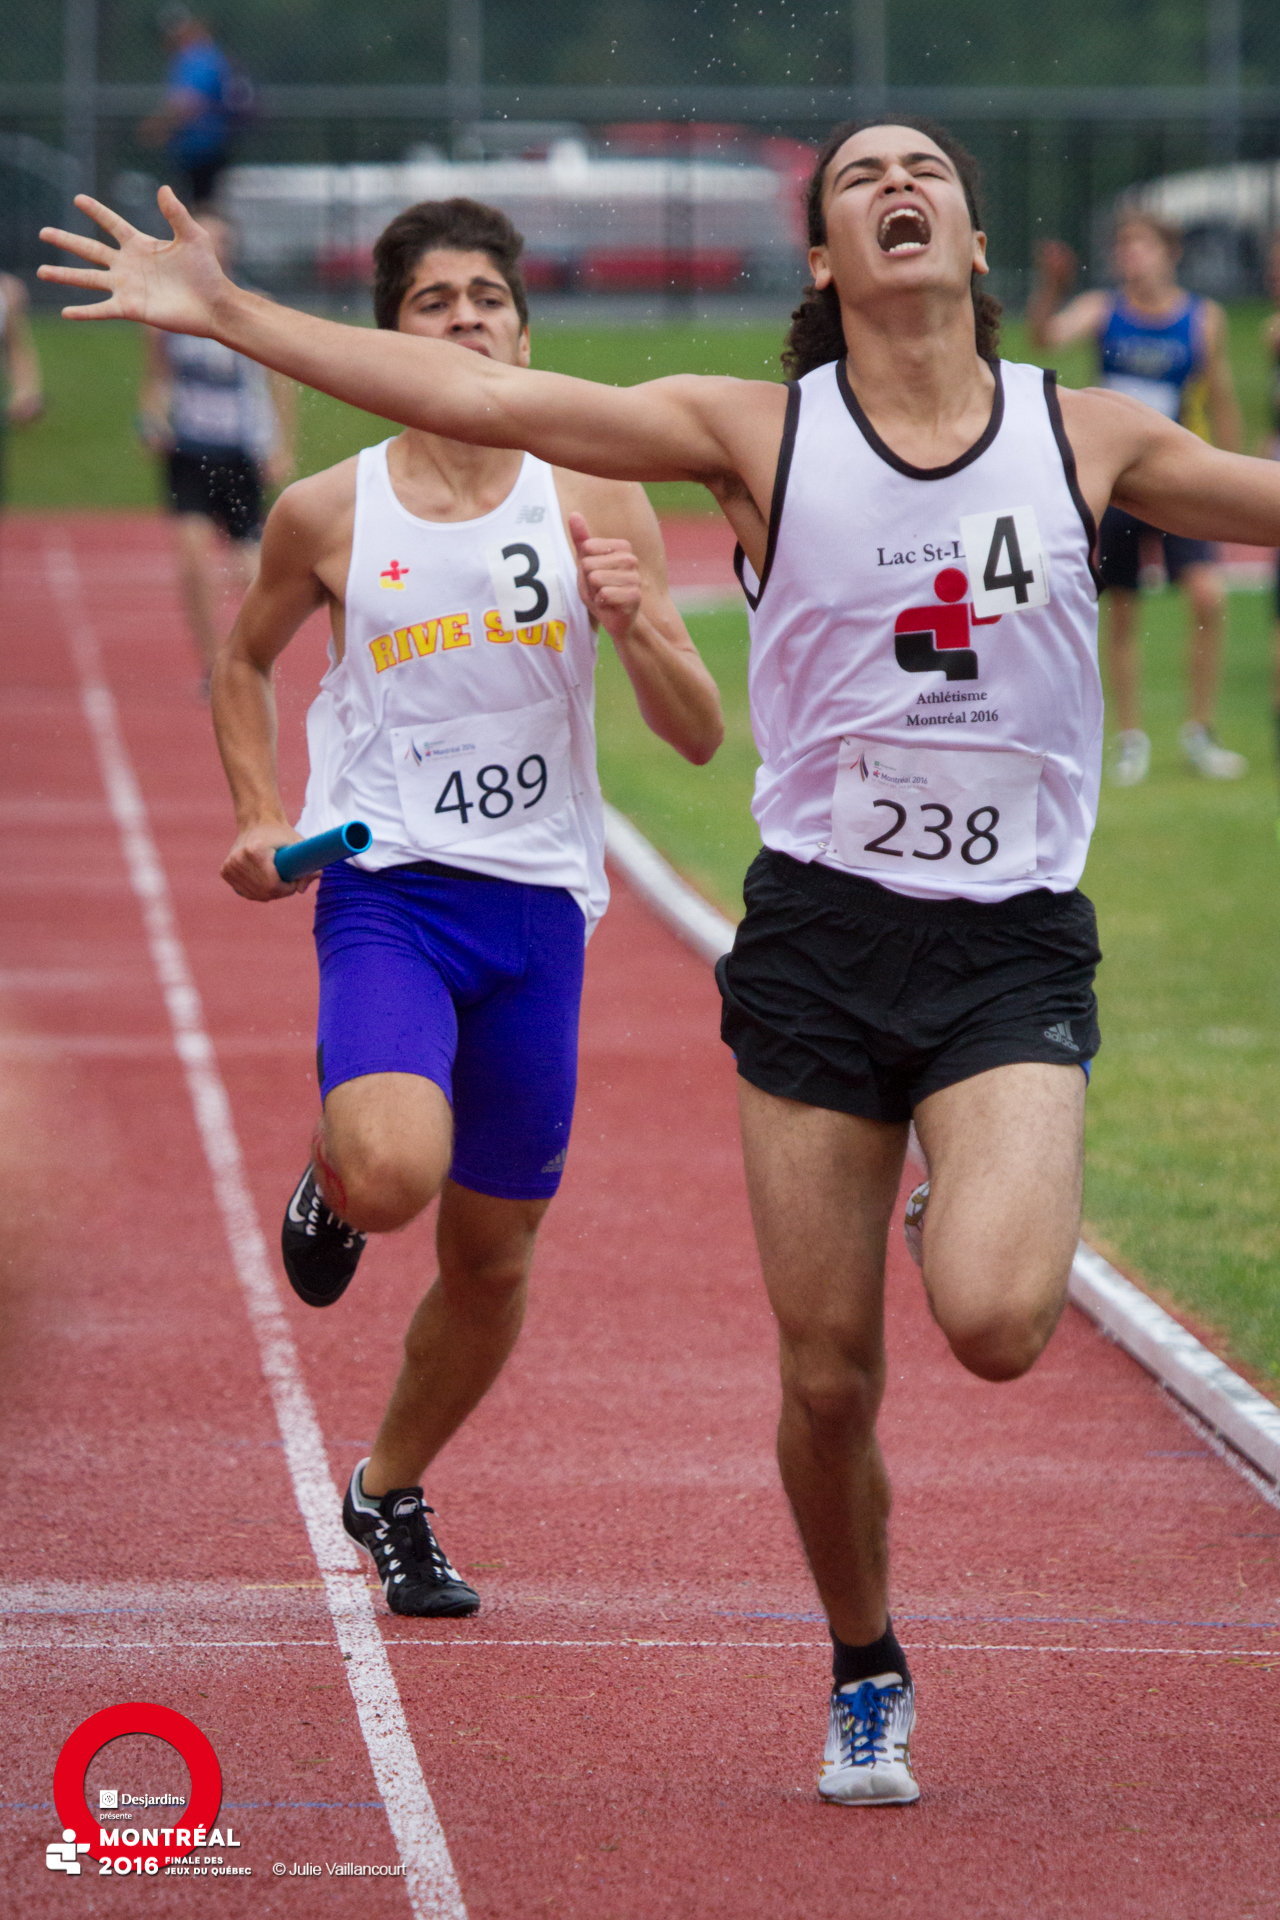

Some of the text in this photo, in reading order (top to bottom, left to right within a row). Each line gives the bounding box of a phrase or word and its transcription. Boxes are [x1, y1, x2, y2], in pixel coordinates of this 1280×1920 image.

[501, 542, 549, 623] 3
[877, 540, 966, 566] Lac St-L
[983, 515, 1035, 605] 4
[368, 612, 472, 674] RIVE
[906, 709, 999, 726] Montréal 2016
[916, 690, 988, 705] Athlétisme
[434, 754, 547, 824] 489
[881, 772, 911, 785] Montréal
[912, 776, 928, 785] 2016
[863, 799, 1000, 865] 238
